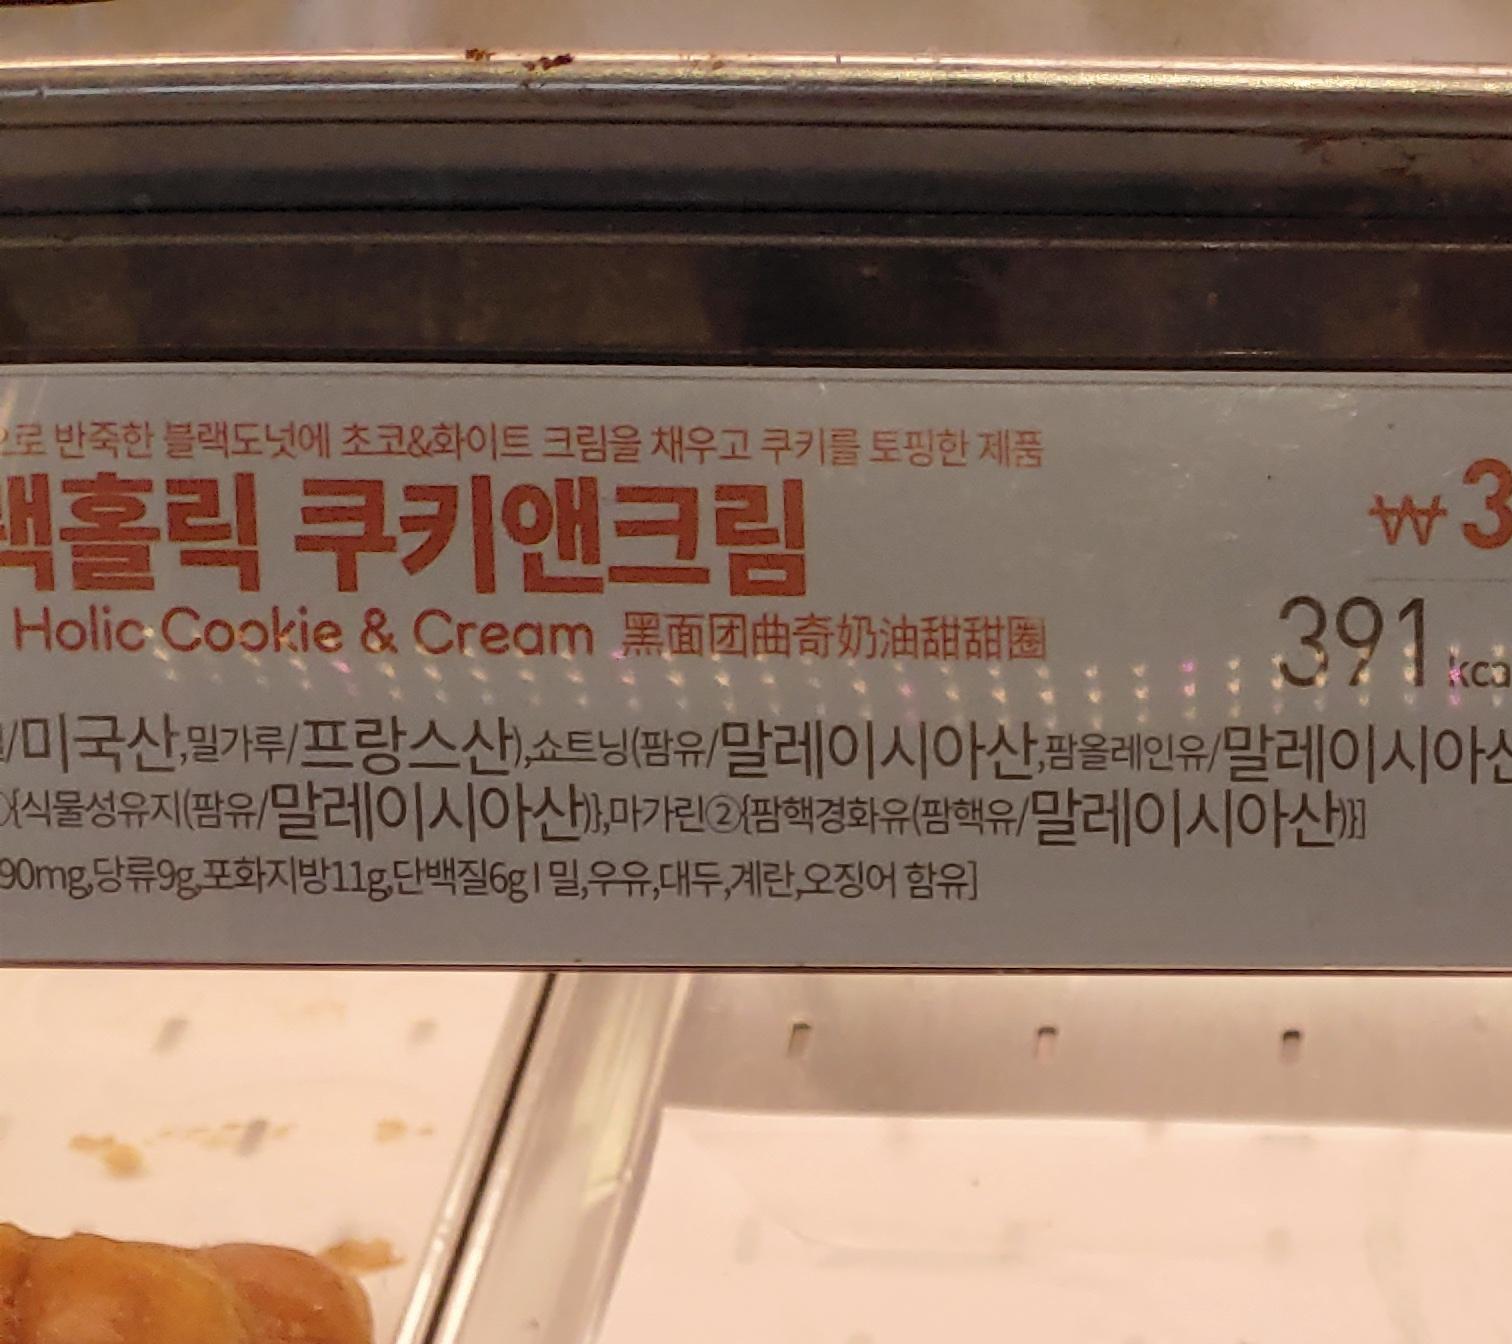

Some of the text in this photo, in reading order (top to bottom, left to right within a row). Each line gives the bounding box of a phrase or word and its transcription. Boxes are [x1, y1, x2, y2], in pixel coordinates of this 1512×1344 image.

[0, 421, 1044, 469] 로 반죽한 블랙도넛에 초코&화이트 크림을 채우고 쿠키를 토핑한 제품
[294, 473, 806, 598] 쿠키앤크림
[13, 603, 594, 656] Holic Cookie & Cream
[621, 610, 1047, 661] 黑面团曲奇奶油甜甜圈
[1277, 595, 1426, 688] 391
[903, 859, 979, 901] 함유]
